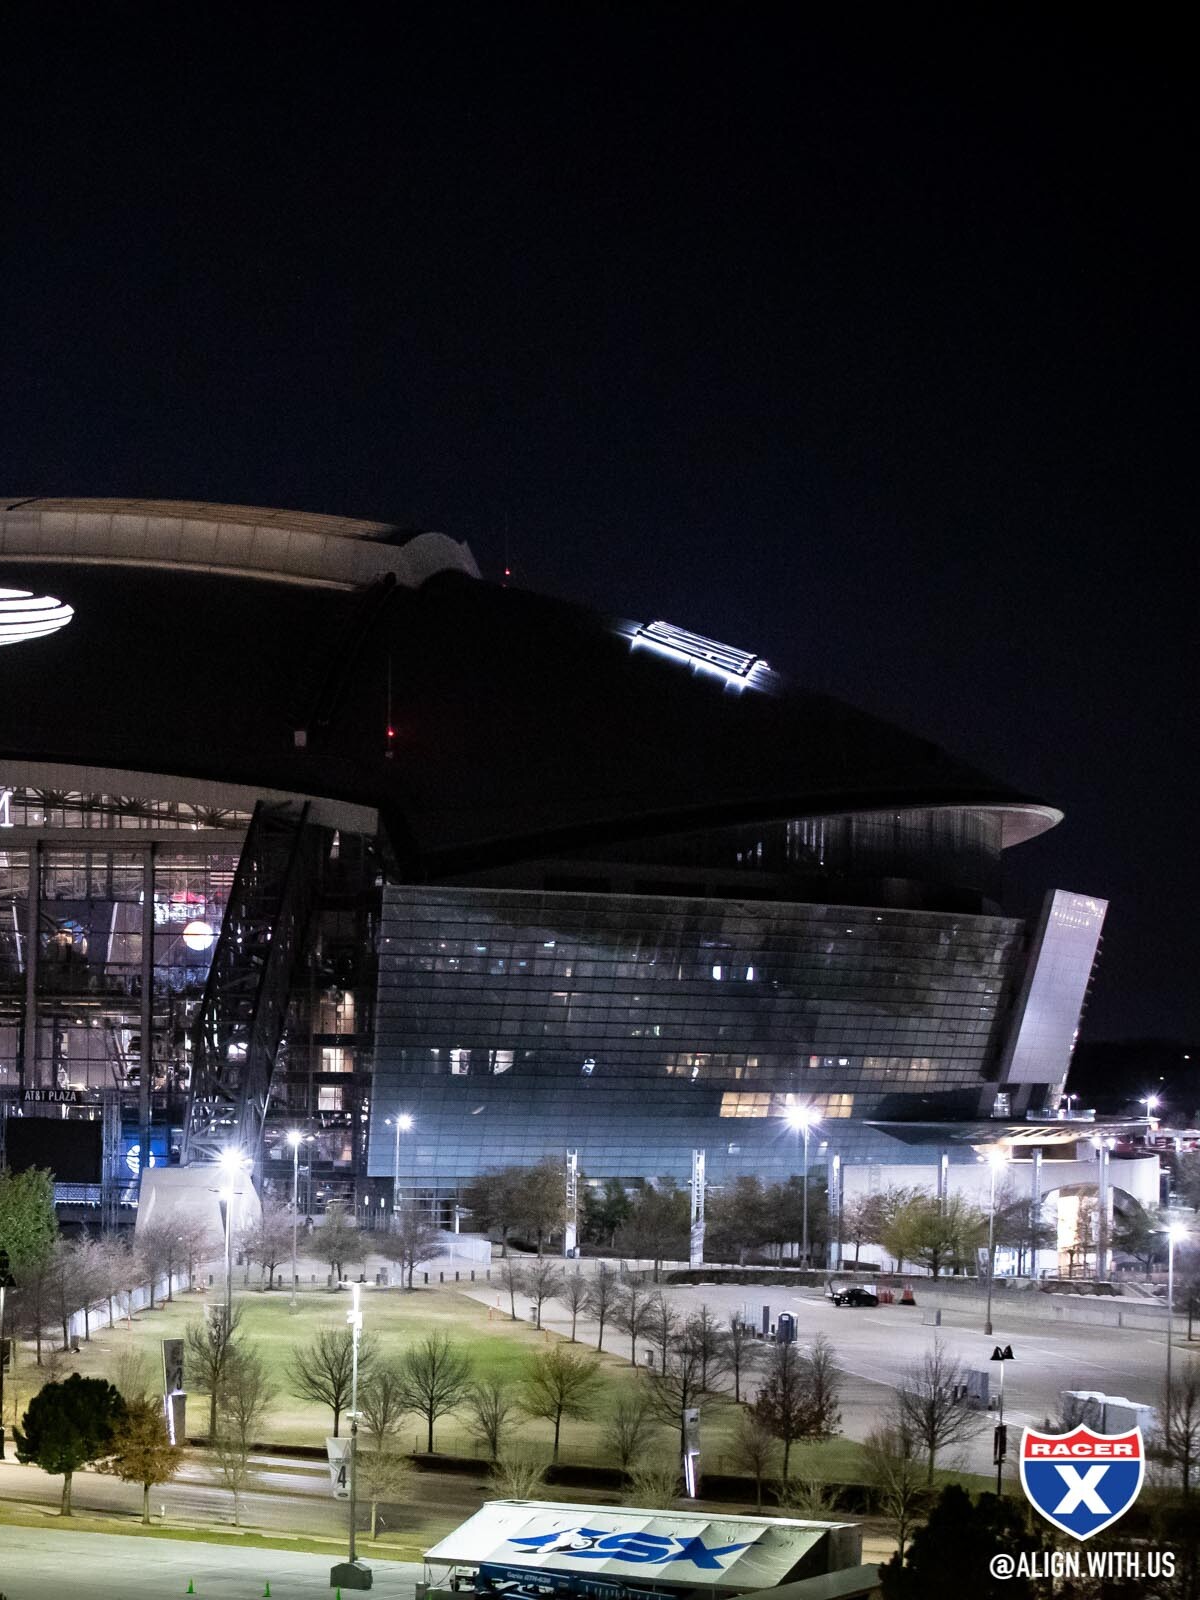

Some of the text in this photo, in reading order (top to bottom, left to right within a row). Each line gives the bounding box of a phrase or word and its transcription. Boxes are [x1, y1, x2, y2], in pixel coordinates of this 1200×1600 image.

[24, 1090, 77, 1102] AT&T PLAZA
[337, 1465, 347, 1489] 4
